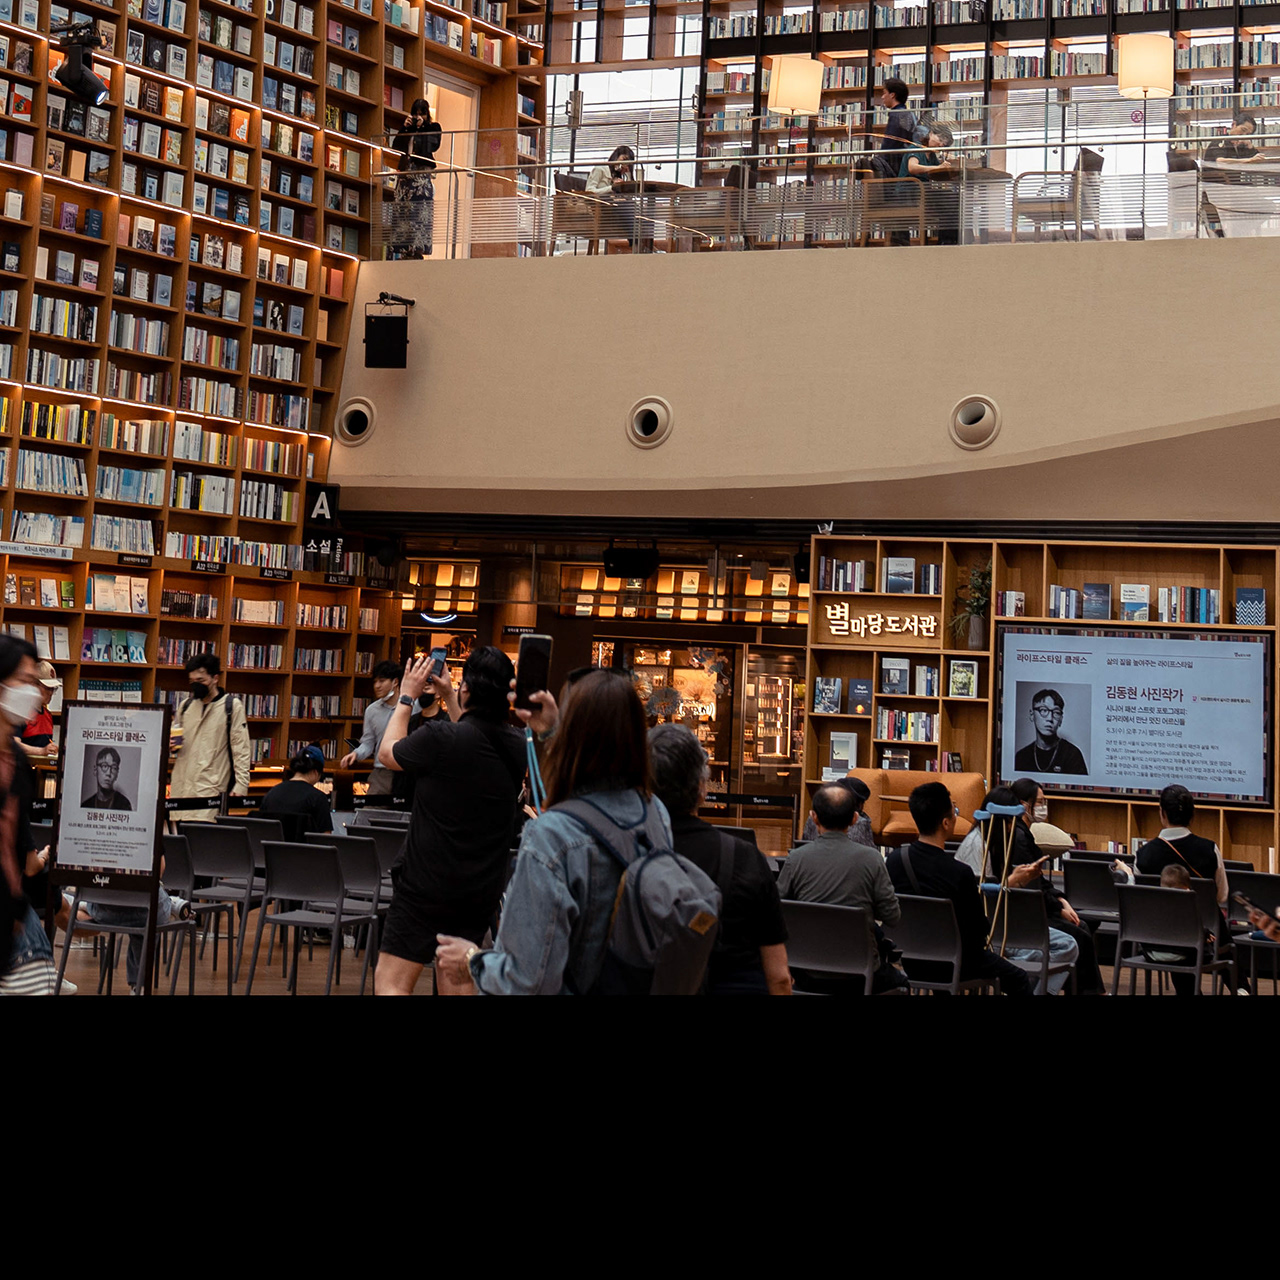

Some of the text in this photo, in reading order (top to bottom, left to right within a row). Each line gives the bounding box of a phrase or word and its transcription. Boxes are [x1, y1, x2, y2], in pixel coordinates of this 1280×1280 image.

[311, 491, 331, 519] A
[306, 539, 331, 554] 소설
[335, 538, 344, 564] Fiction
[1016, 653, 1088, 665] 라이프스타일 클래스
[1106, 685, 1138, 700] 김동현
[1140, 687, 1184, 703] 사진작가
[82, 730, 124, 742] 라이프스타일
